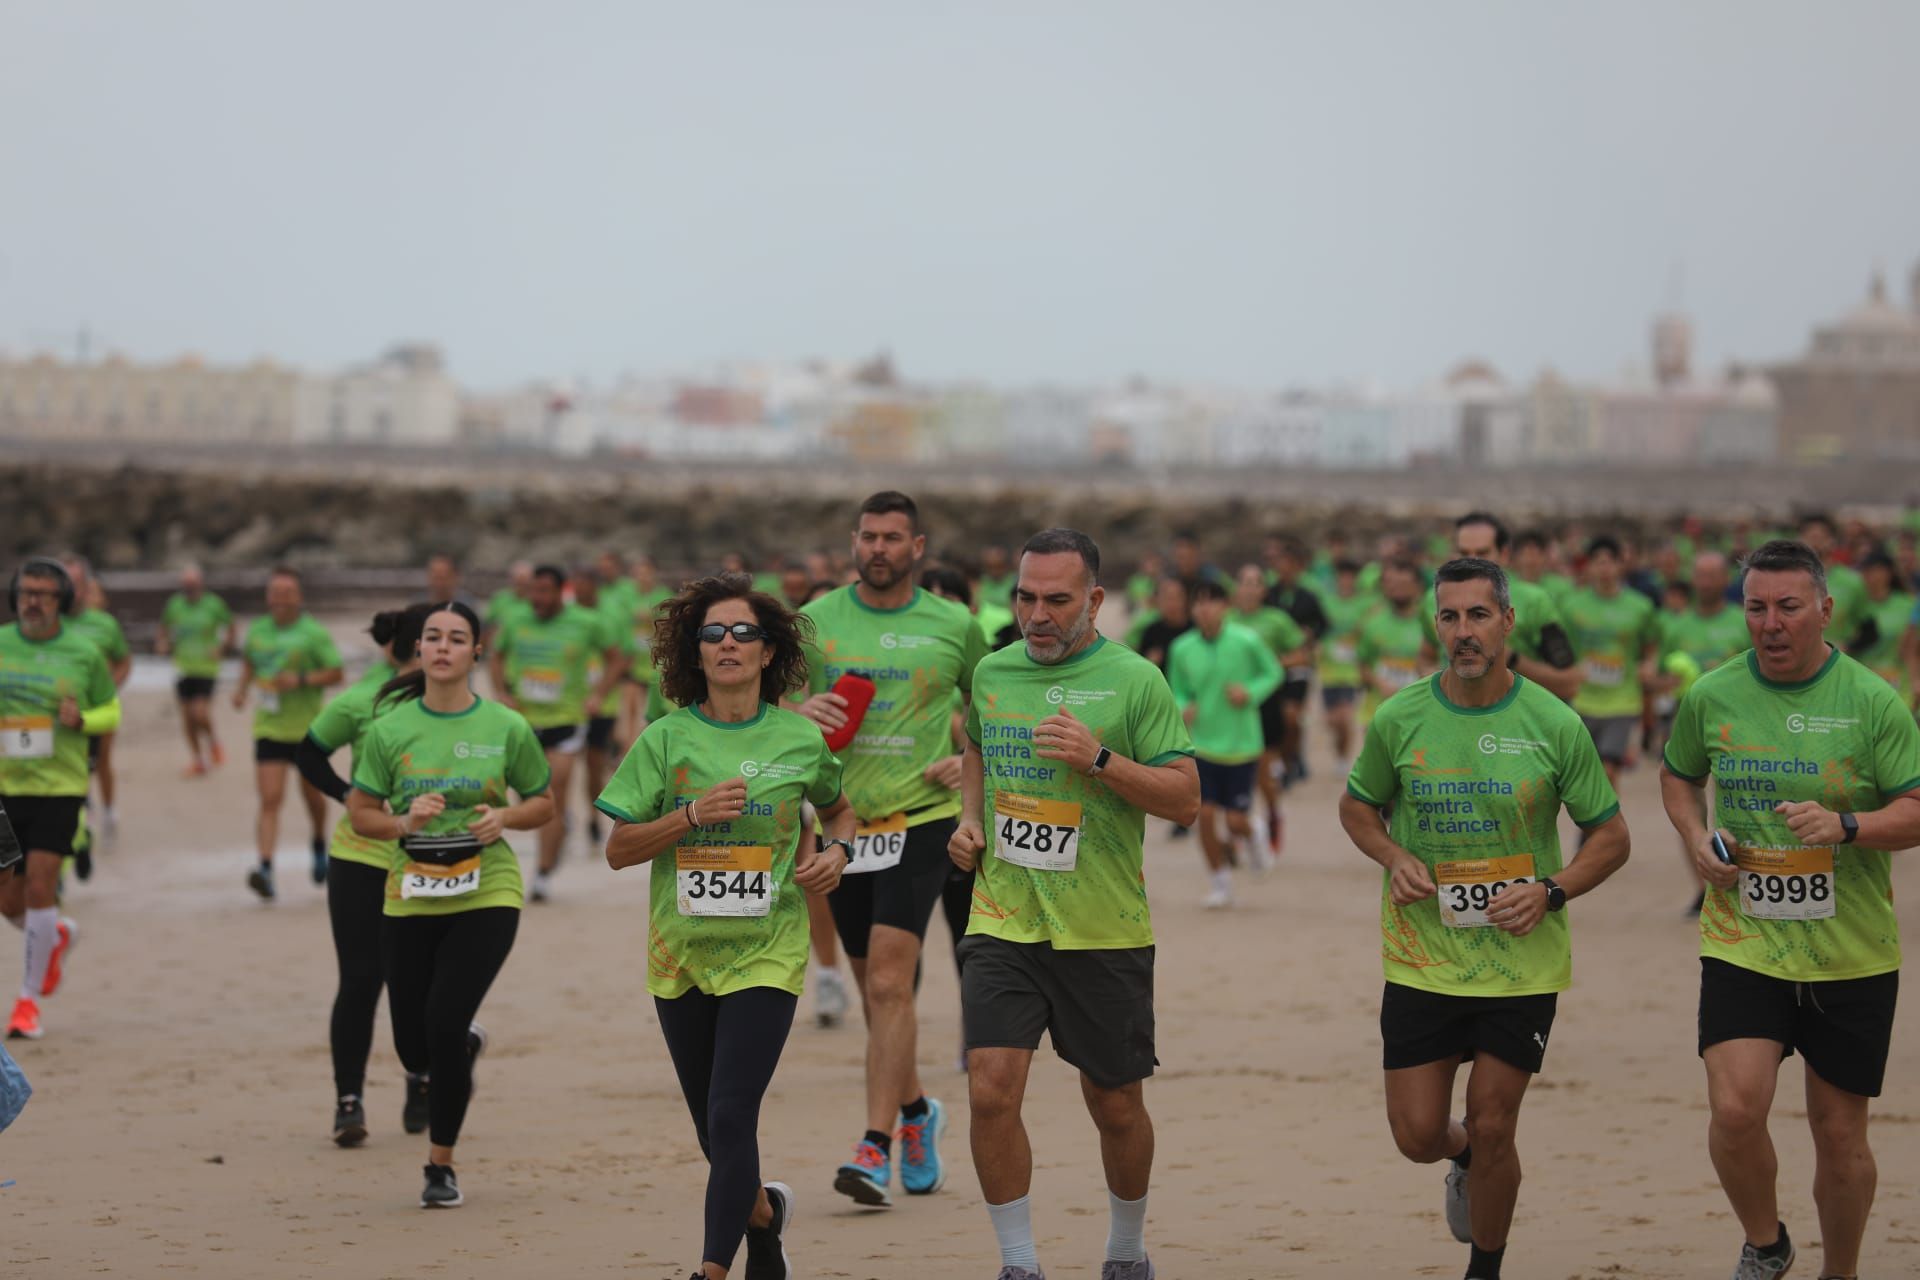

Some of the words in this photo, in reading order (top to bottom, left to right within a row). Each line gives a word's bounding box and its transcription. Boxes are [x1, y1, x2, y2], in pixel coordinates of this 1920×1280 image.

[984, 723, 997, 738] En
[996, 760, 1057, 781] cáncer
[1718, 755, 1735, 772] En
[1740, 757, 1819, 775] marcha
[420, 775, 481, 790] marcha
[1411, 780, 1432, 795] En
[1438, 778, 1513, 795] marcha
[1719, 776, 1776, 792] contra
[740, 801, 773, 816] cha
[1416, 798, 1473, 814] contra
[1724, 794, 1735, 809] el
[1418, 816, 1431, 832] el
[1435, 817, 1501, 833] cáncer
[1001, 817, 1077, 855] 4287
[856, 833, 902, 858] 706
[412, 871, 475, 890] 3704
[687, 871, 767, 900] 3544
[1748, 873, 1829, 904] 3998
[1451, 878, 1529, 912] 399
